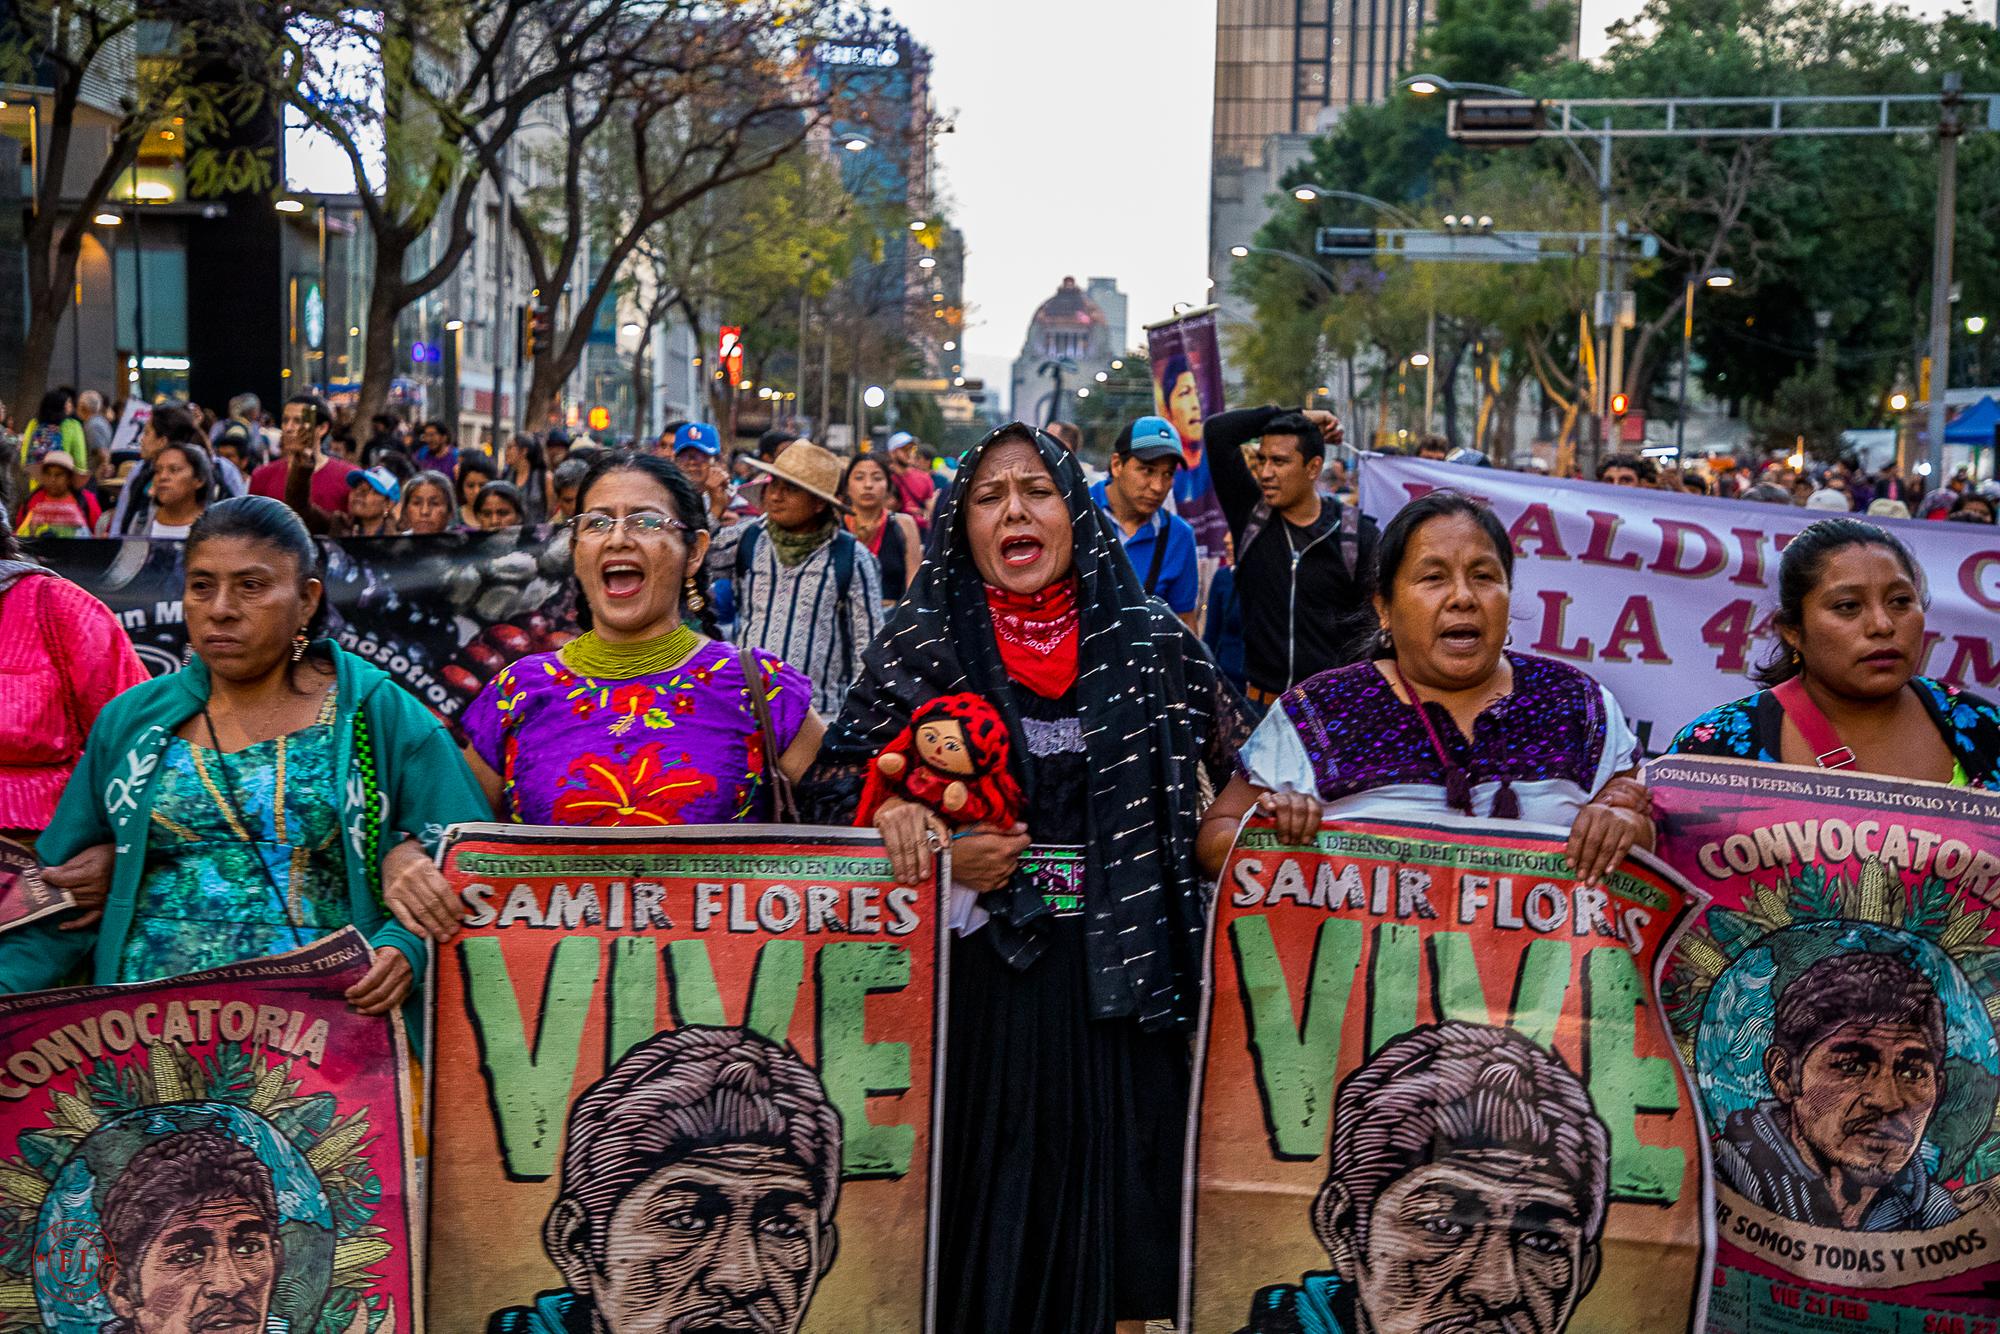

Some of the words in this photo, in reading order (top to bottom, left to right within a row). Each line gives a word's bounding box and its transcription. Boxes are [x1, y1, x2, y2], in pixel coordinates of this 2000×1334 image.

[1531, 590, 1672, 664] LA
[339, 632, 459, 715] nosotros
[1652, 767, 1729, 787] JORNADAS
[1730, 775, 1749, 788] EN
[1750, 778, 1813, 796] DEFENSA
[1816, 784, 1845, 799] DEL
[1847, 788, 1945, 811] TERRITORIO
[1947, 800, 1960, 812] Y
[1962, 802, 1981, 816] LA
[558, 858, 647, 874] DEFENSOR
[651, 858, 686, 873] DEL
[689, 858, 802, 875] TERRITORIO
[805, 861, 828, 876] EN
[831, 861, 896, 877] MOREL
[1325, 835, 1413, 860] DEFENSOR
[1418, 845, 1453, 862] DEL
[1698, 818, 2000, 906] CONVOCATORI
[461, 882, 676, 930] SAMIR
[694, 883, 922, 936] FLORES
[1231, 857, 1439, 920] SAMIR
[1457, 873, 1652, 955] FLORS
[217, 968, 231, 980] Y
[234, 967, 256, 978] LA
[258, 961, 312, 976] MADRE
[312, 943, 364, 971] TIERRA
[0, 999, 330, 1099] CONVOCATORIA
[1733, 1215, 1807, 1262] SOMOS
[1813, 1243, 1887, 1273] TODAS
[1891, 1248, 1905, 1271] Y
[1909, 1228, 1988, 1269] TODOS
[1769, 1283, 1802, 1310] VIE
[1804, 1295, 1827, 1315] 21
[1830, 1298, 1870, 1322] FEB
